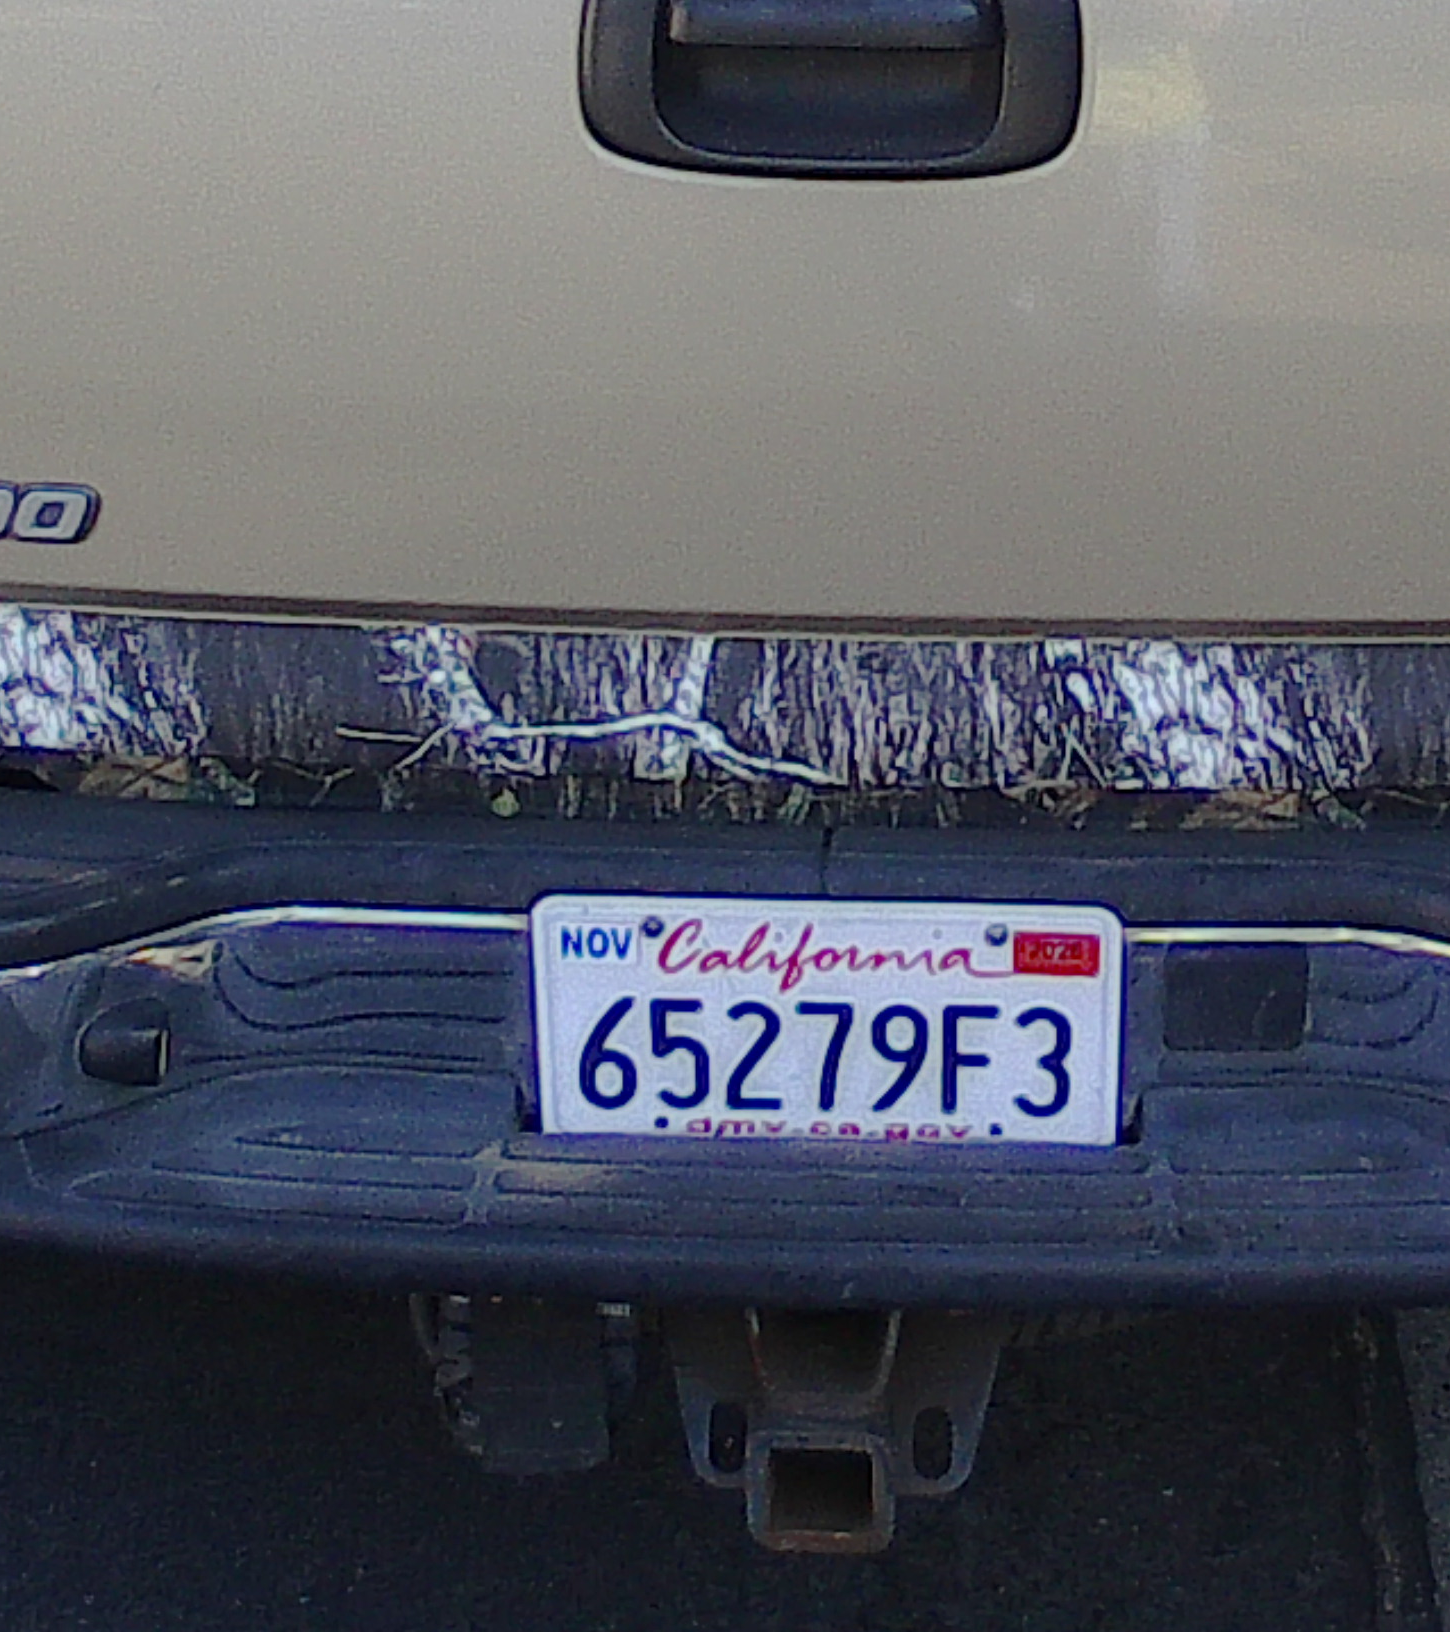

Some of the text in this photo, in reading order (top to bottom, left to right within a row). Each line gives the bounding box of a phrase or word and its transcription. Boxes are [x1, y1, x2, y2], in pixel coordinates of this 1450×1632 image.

[561, 926, 633, 960] NOV
[658, 918, 1015, 993] California
[578, 996, 1073, 1117] 65279F3
